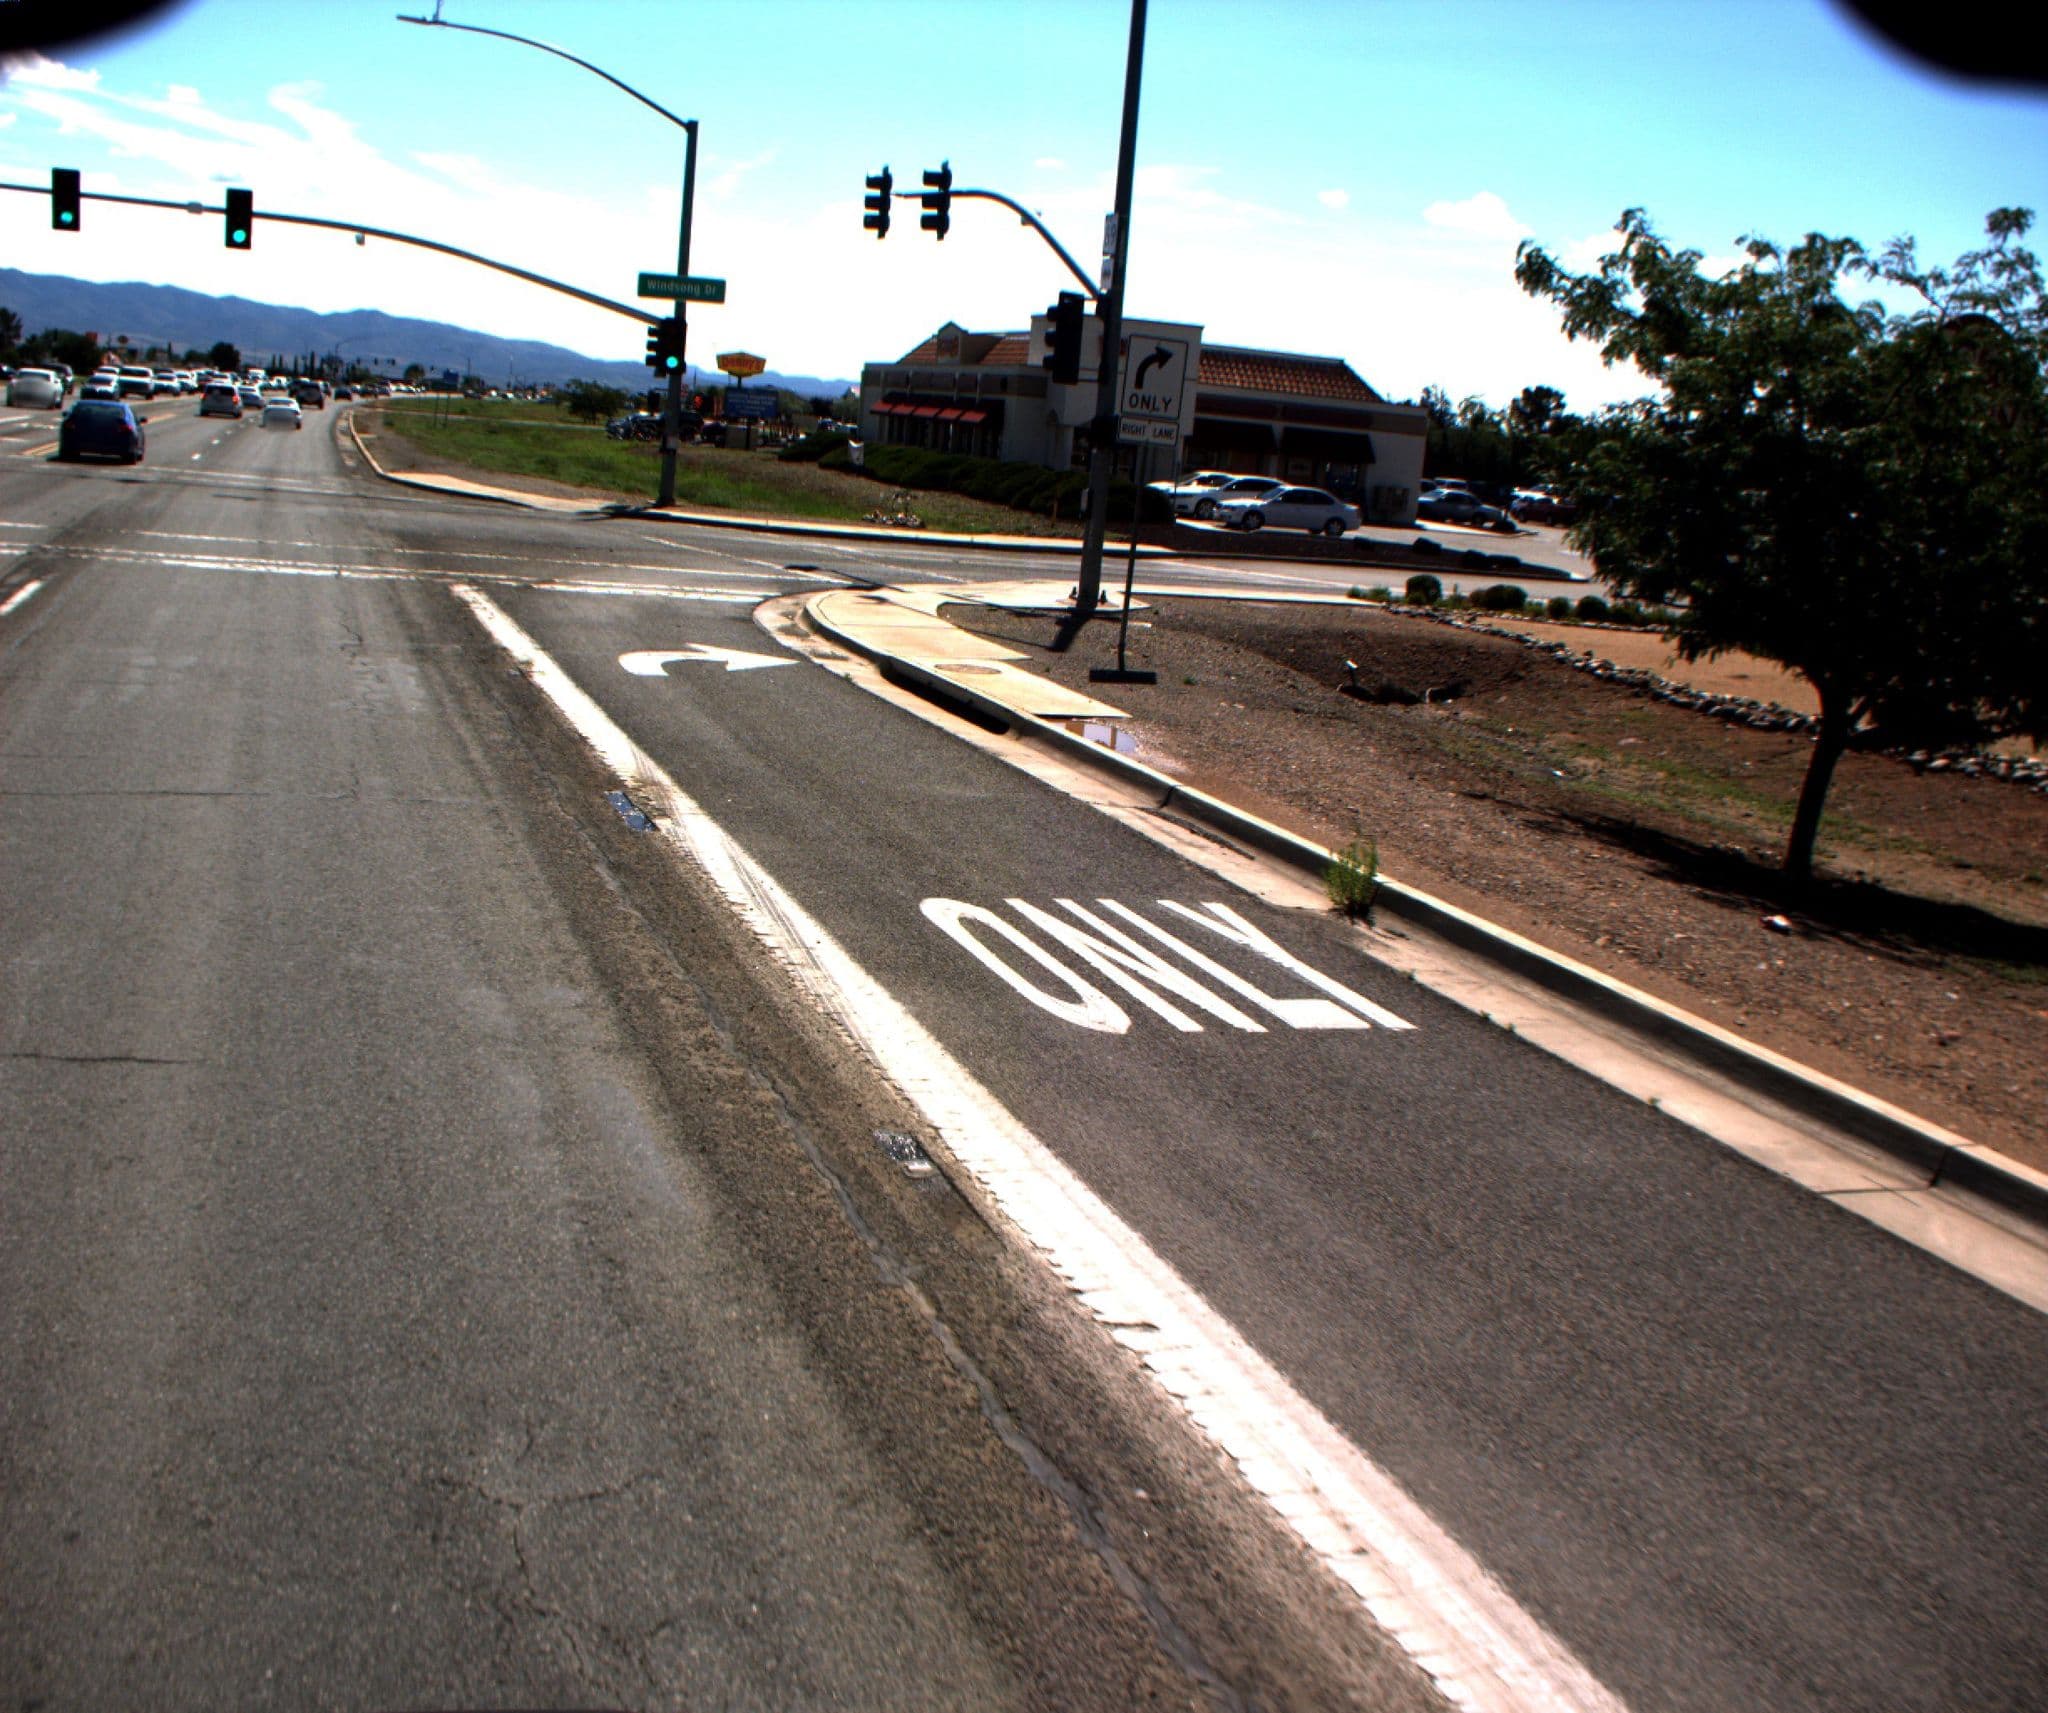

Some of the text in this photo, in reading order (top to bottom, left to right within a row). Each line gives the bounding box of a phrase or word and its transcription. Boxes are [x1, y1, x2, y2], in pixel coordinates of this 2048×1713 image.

[647, 279, 716, 297] Windsong Dr
[1128, 393, 1173, 413] ONLY
[1121, 423, 1176, 440] RIGHT LANE
[919, 897, 1418, 1035] ONLY
